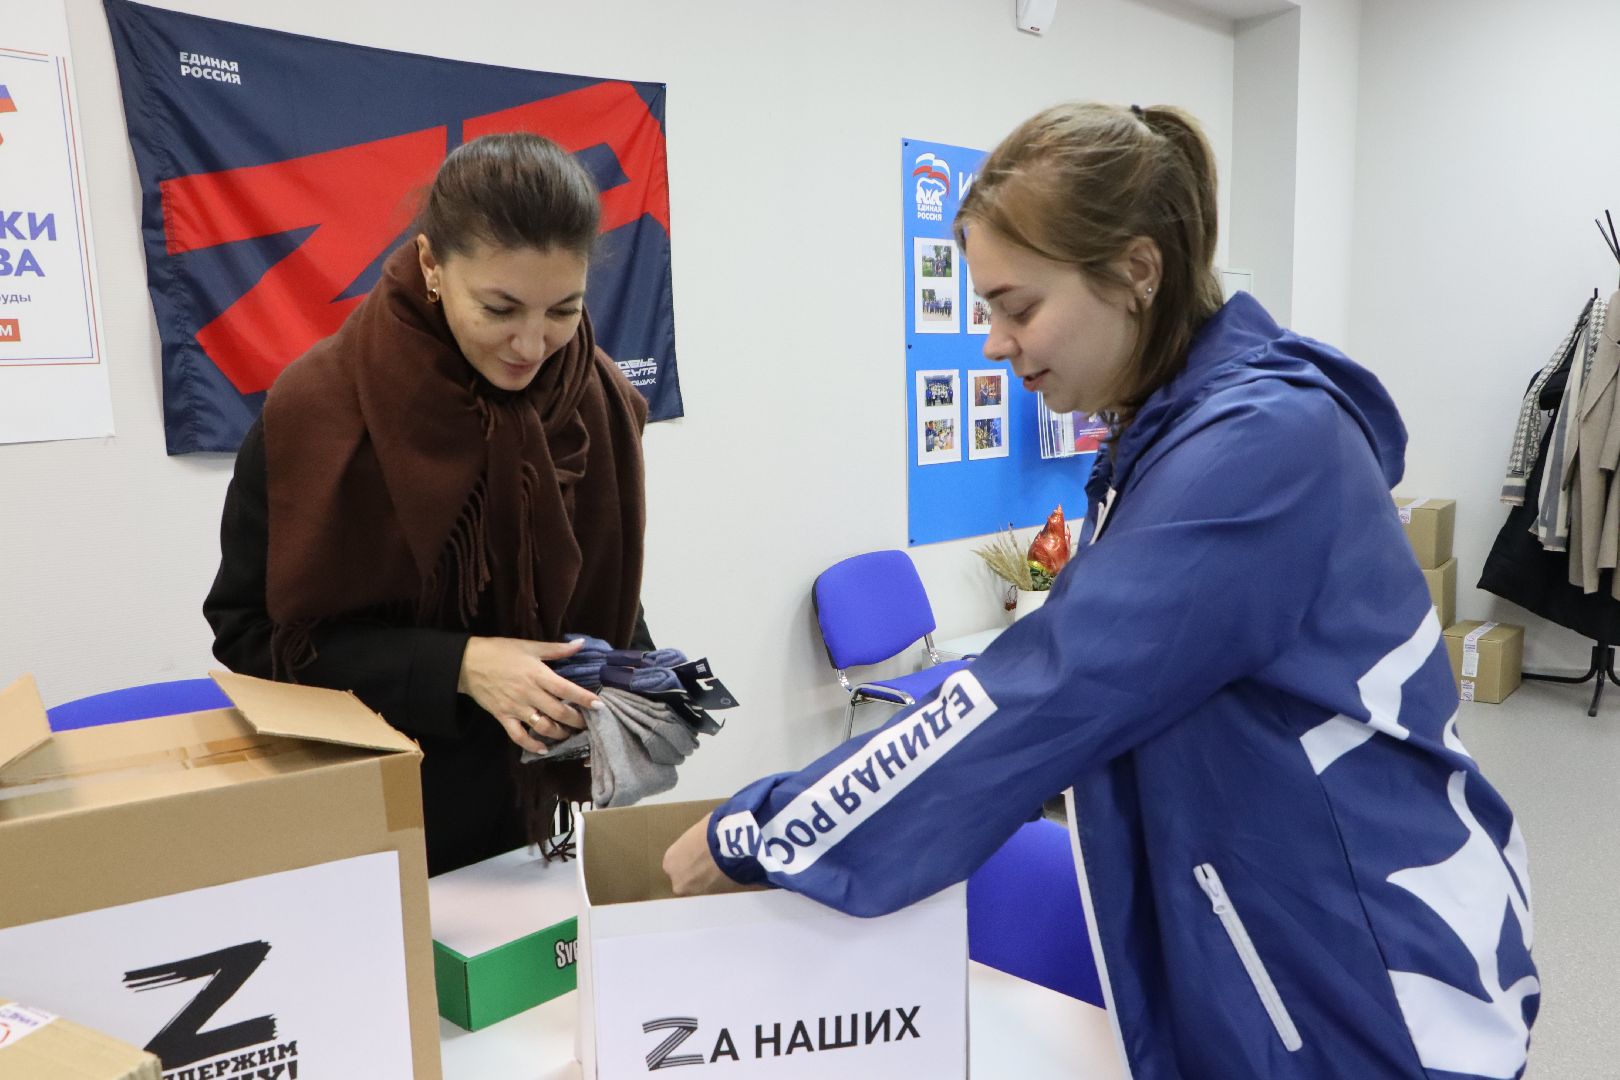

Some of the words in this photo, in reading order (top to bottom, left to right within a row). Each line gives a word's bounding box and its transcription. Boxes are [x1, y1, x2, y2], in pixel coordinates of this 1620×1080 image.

[179, 51, 239, 72] ЕДИНАЯ
[180, 64, 241, 85] РОССИЯ
[917, 203, 942, 213] ЕДИНАЯ
[917, 211, 942, 221] РОССИЯ
[0, 293, 32, 305] уды
[614, 357, 657, 370] ОВЫЕ
[829, 683, 976, 815] ЕДИНАЯ
[755, 1005, 922, 1060] НАШИХ
